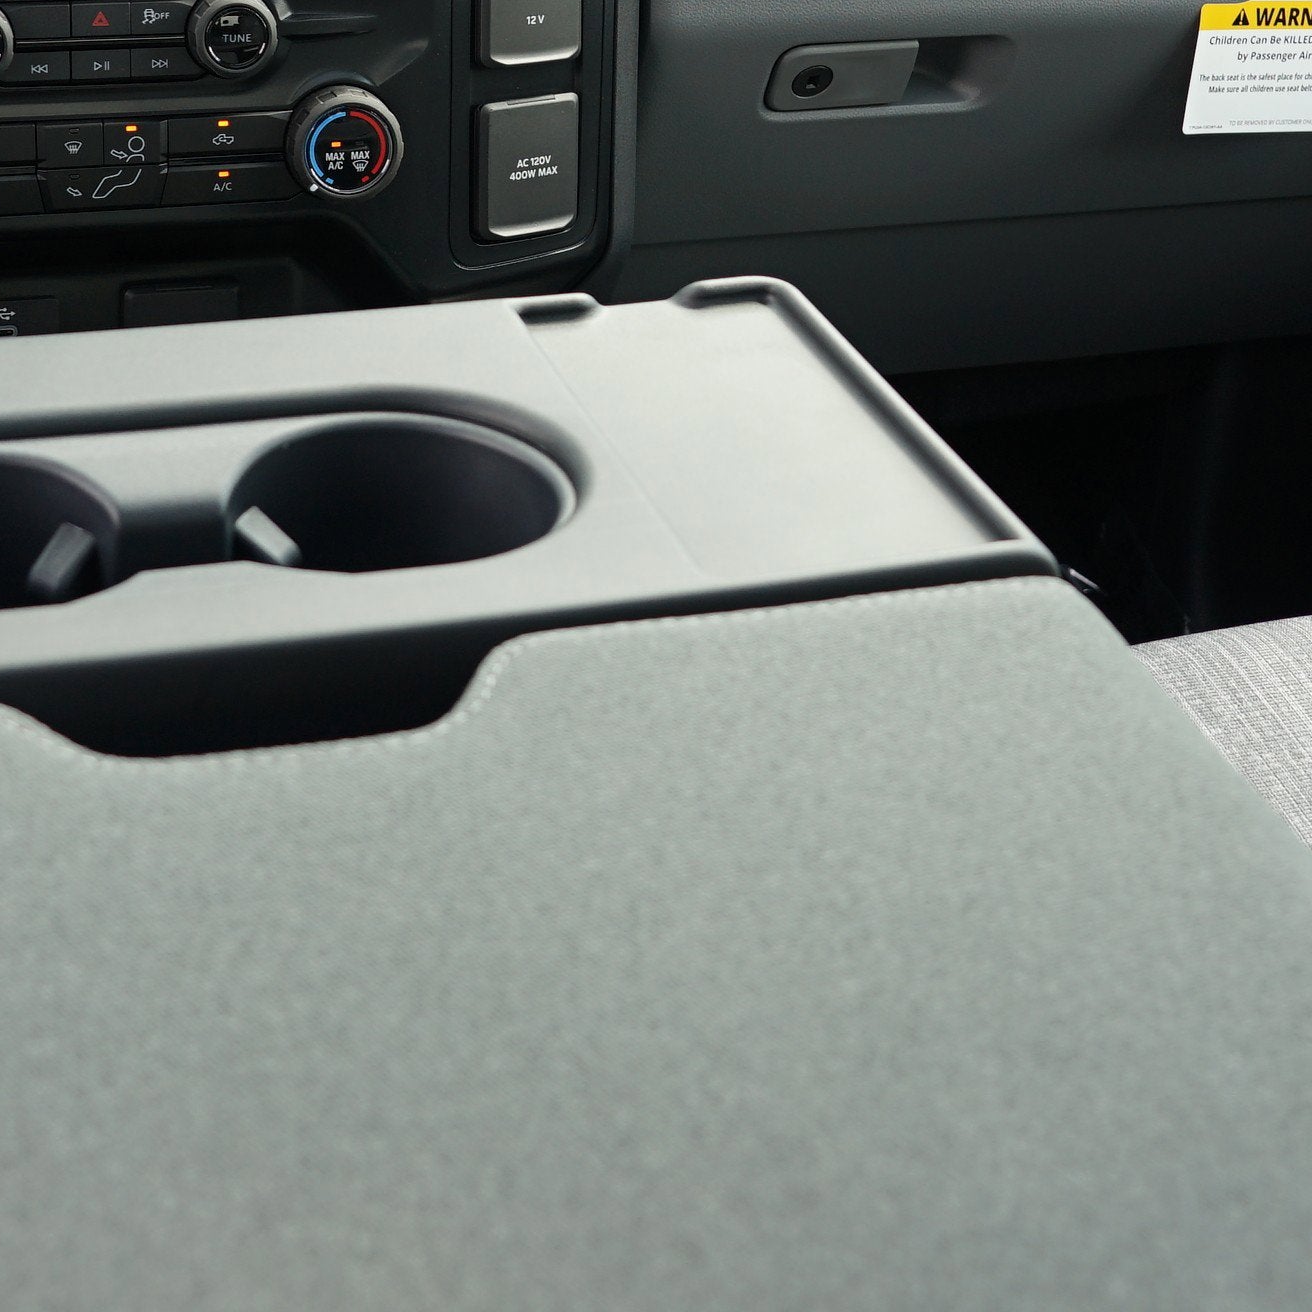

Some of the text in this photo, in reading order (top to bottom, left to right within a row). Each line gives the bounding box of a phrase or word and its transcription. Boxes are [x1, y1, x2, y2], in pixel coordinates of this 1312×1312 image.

[155, 11, 170, 21] OFF
[526, 15, 545, 25] 12 V
[223, 33, 252, 44] TUNE
[1209, 35, 1248, 46] Children
[1251, 35, 1268, 45] Can
[1270, 35, 1282, 45] Be
[1237, 51, 1249, 63] by
[1250, 51, 1297, 63] Passenger
[1299, 51, 1312, 60] Air
[1199, 74, 1210, 82] The
[1211, 73, 1225, 81] back
[1247, 73, 1257, 81] the
[1258, 73, 1276, 81] safest
[1276, 72, 1293, 82] place
[1293, 73, 1304, 81] for
[1249, 85, 1274, 93] children
[1275, 118, 1302, 126] CUSTOMER
[325, 151, 345, 162] MAX
[351, 150, 370, 160] MAX
[328, 161, 344, 171] A/C
[517, 154, 552, 169] AC 120V
[510, 165, 559, 181] 400W MAX
[213, 182, 233, 192] A/C
